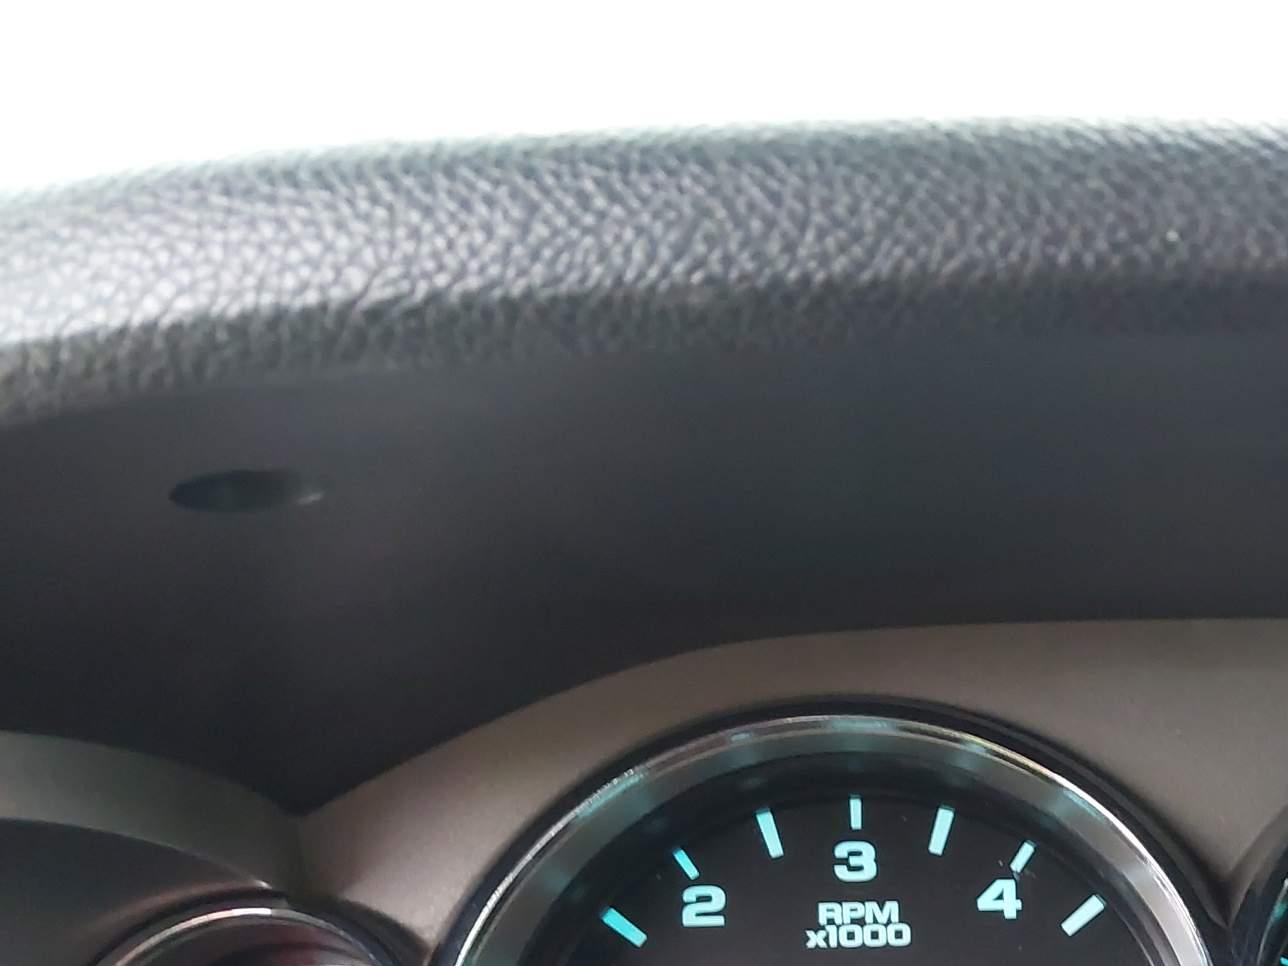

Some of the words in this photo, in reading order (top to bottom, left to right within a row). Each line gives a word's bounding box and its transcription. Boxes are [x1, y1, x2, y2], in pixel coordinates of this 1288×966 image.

[833, 840, 878, 882] 3
[682, 885, 727, 927] 2
[818, 901, 899, 925] RPM
[976, 879, 1022, 919] 4
[806, 924, 911, 948] x1000
